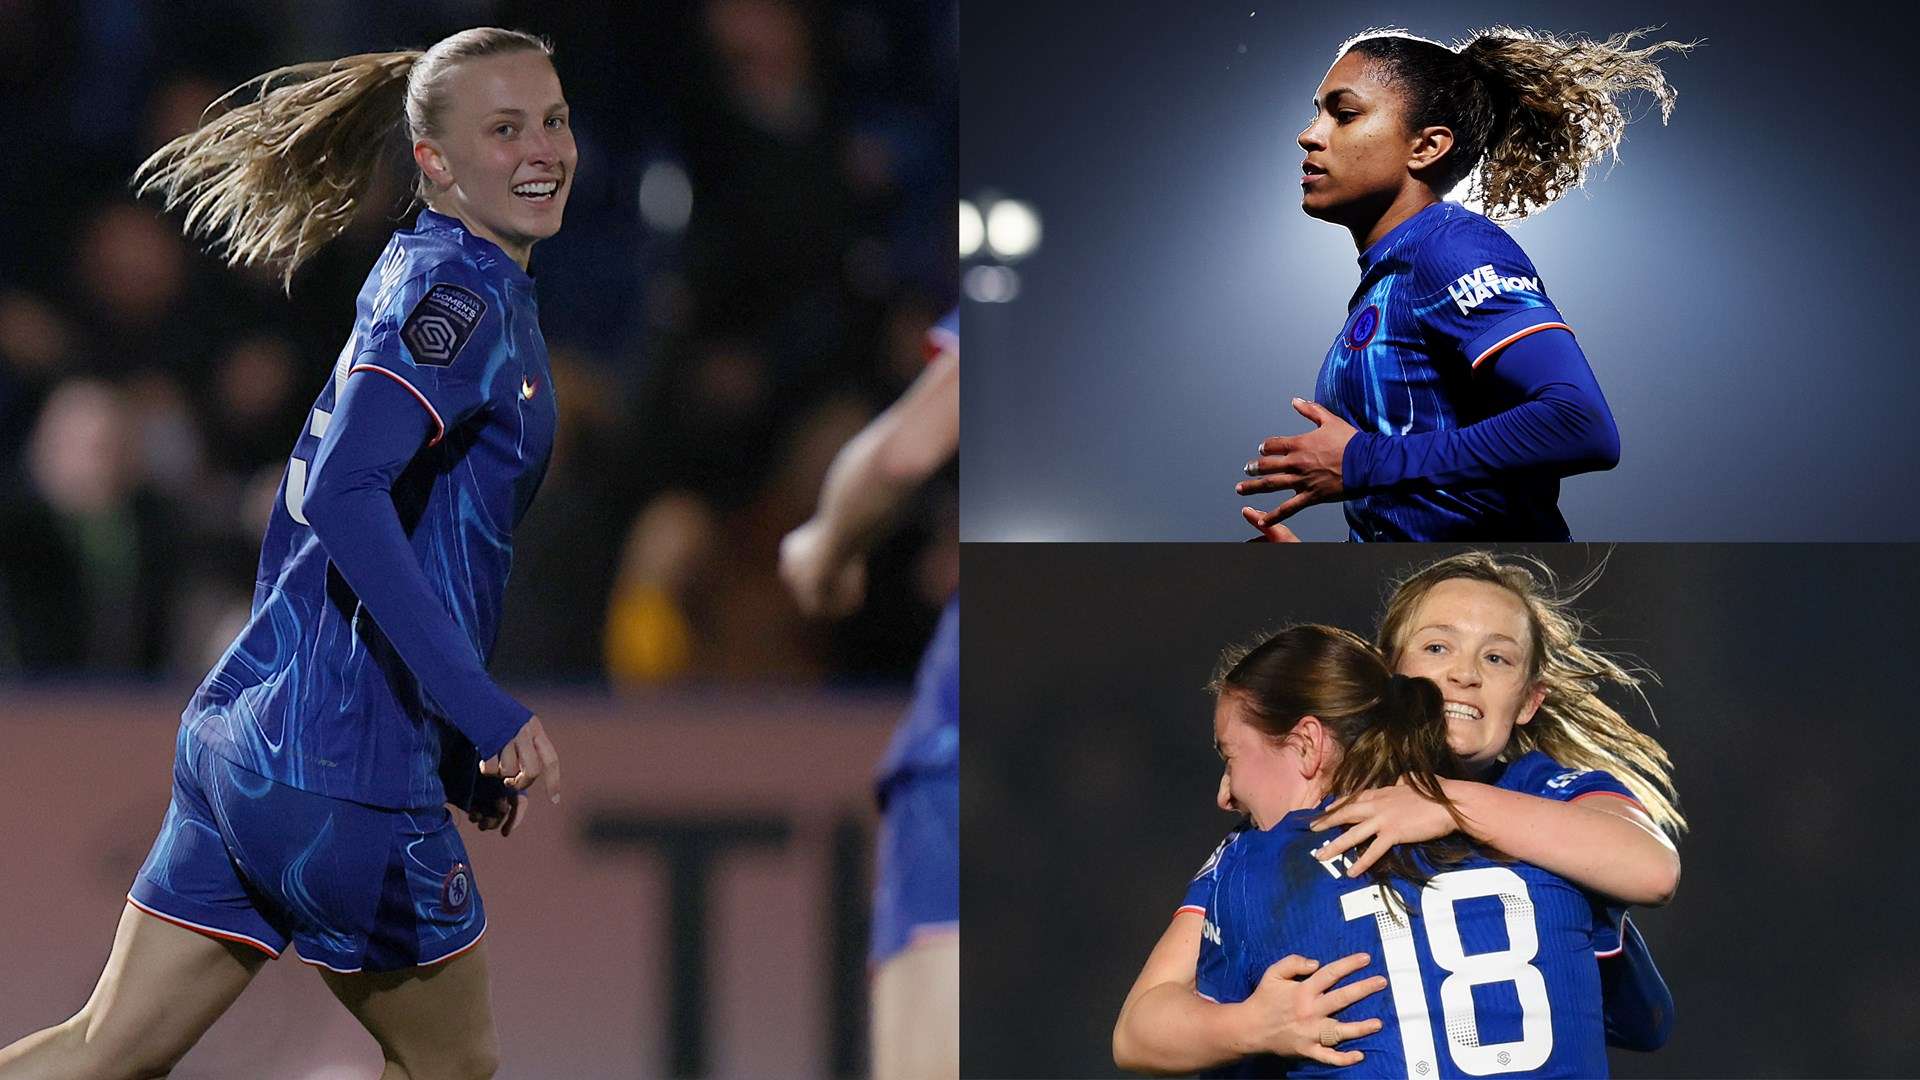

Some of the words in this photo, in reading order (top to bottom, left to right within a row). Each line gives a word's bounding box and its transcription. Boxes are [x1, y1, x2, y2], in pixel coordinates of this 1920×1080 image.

[1447, 264, 1499, 301] LIVE
[1456, 276, 1542, 316] NATION
[432, 291, 477, 319] WOMEN'S
[1340, 866, 1554, 1080] 18
